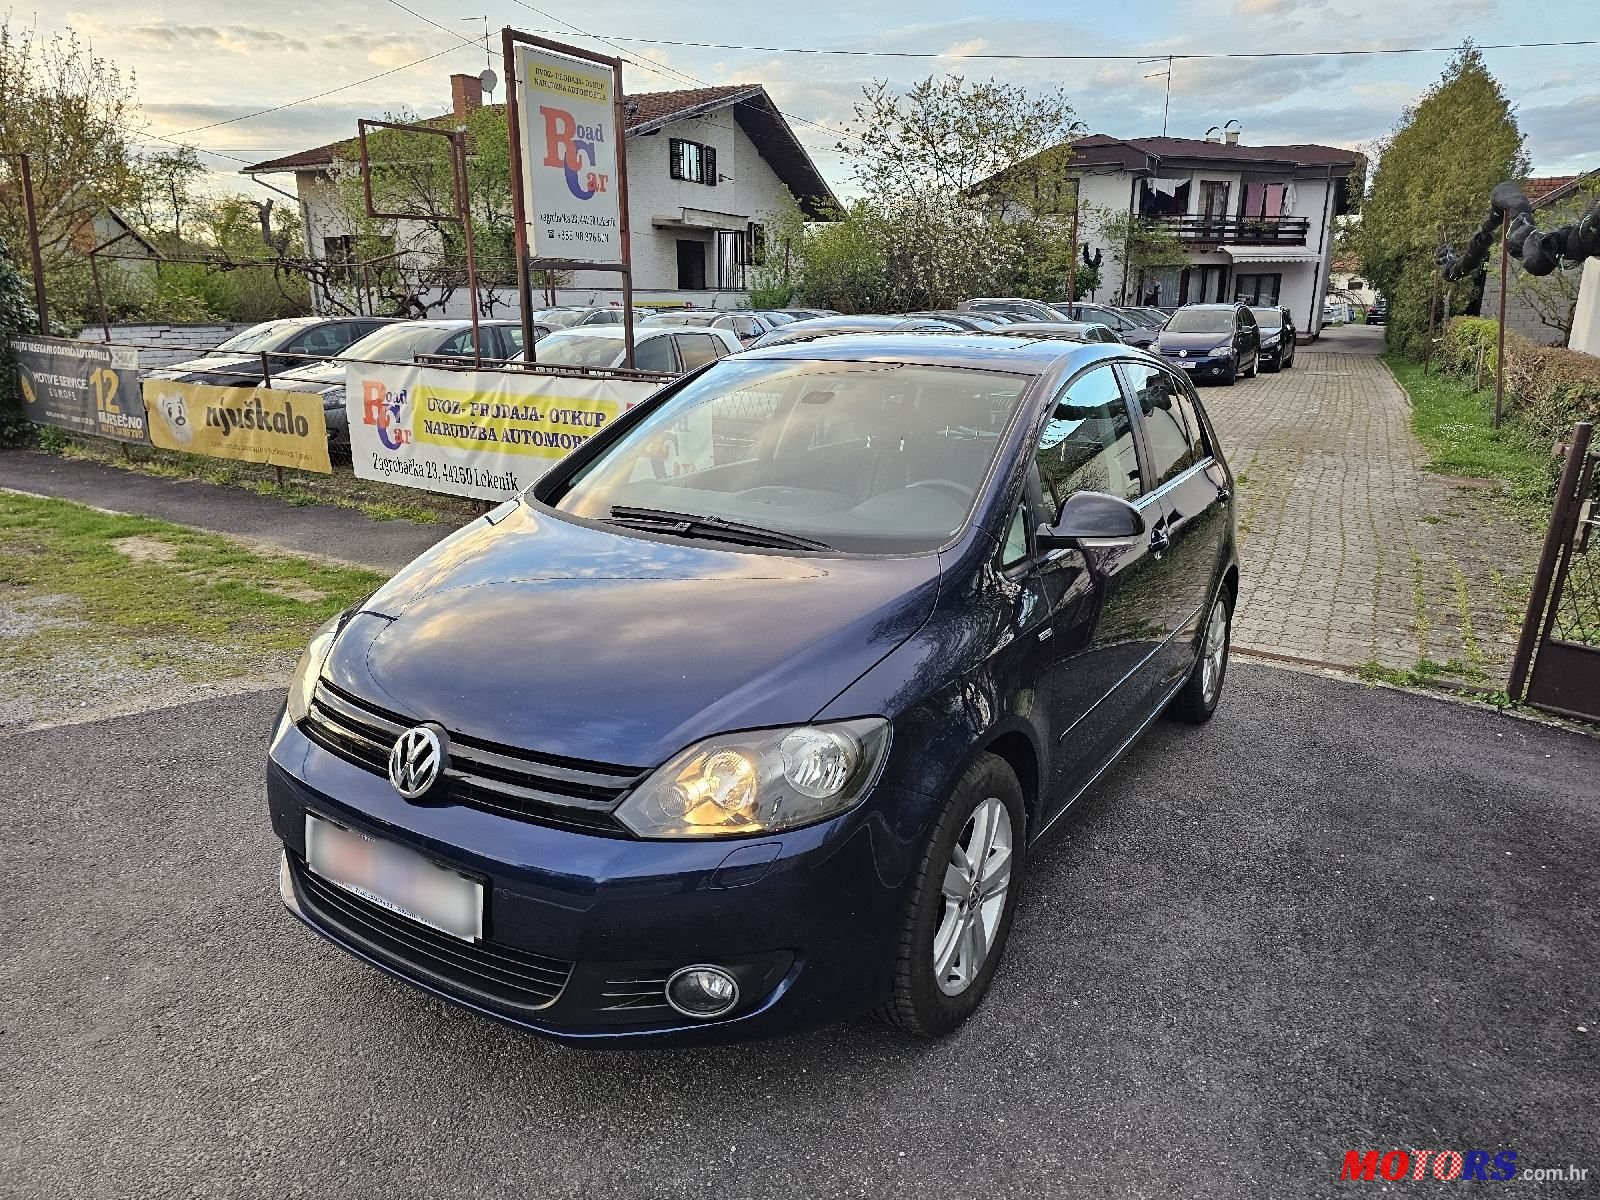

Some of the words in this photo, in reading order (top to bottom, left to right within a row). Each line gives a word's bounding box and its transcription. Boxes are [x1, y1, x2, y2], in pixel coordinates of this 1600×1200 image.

[539, 105, 605, 169] Road
[563, 139, 609, 200] Car
[48, 387, 77, 401] EUROPE
[59, 375, 89, 390] SERVICE
[89, 367, 121, 414] 12
[97, 410, 143, 430] MJESEČNO
[205, 396, 309, 437] njuškalo
[361, 379, 408, 428] Road
[427, 397, 467, 416] UVOZ-
[469, 402, 545, 422] PRODAJA-
[550, 408, 607, 427] OTKUP
[377, 404, 412, 451] Car
[423, 419, 499, 441] NARUDŽBA
[372, 452, 425, 477] Zagrebačka
[425, 461, 441, 483] 23,
[442, 463, 473, 486] 44250
